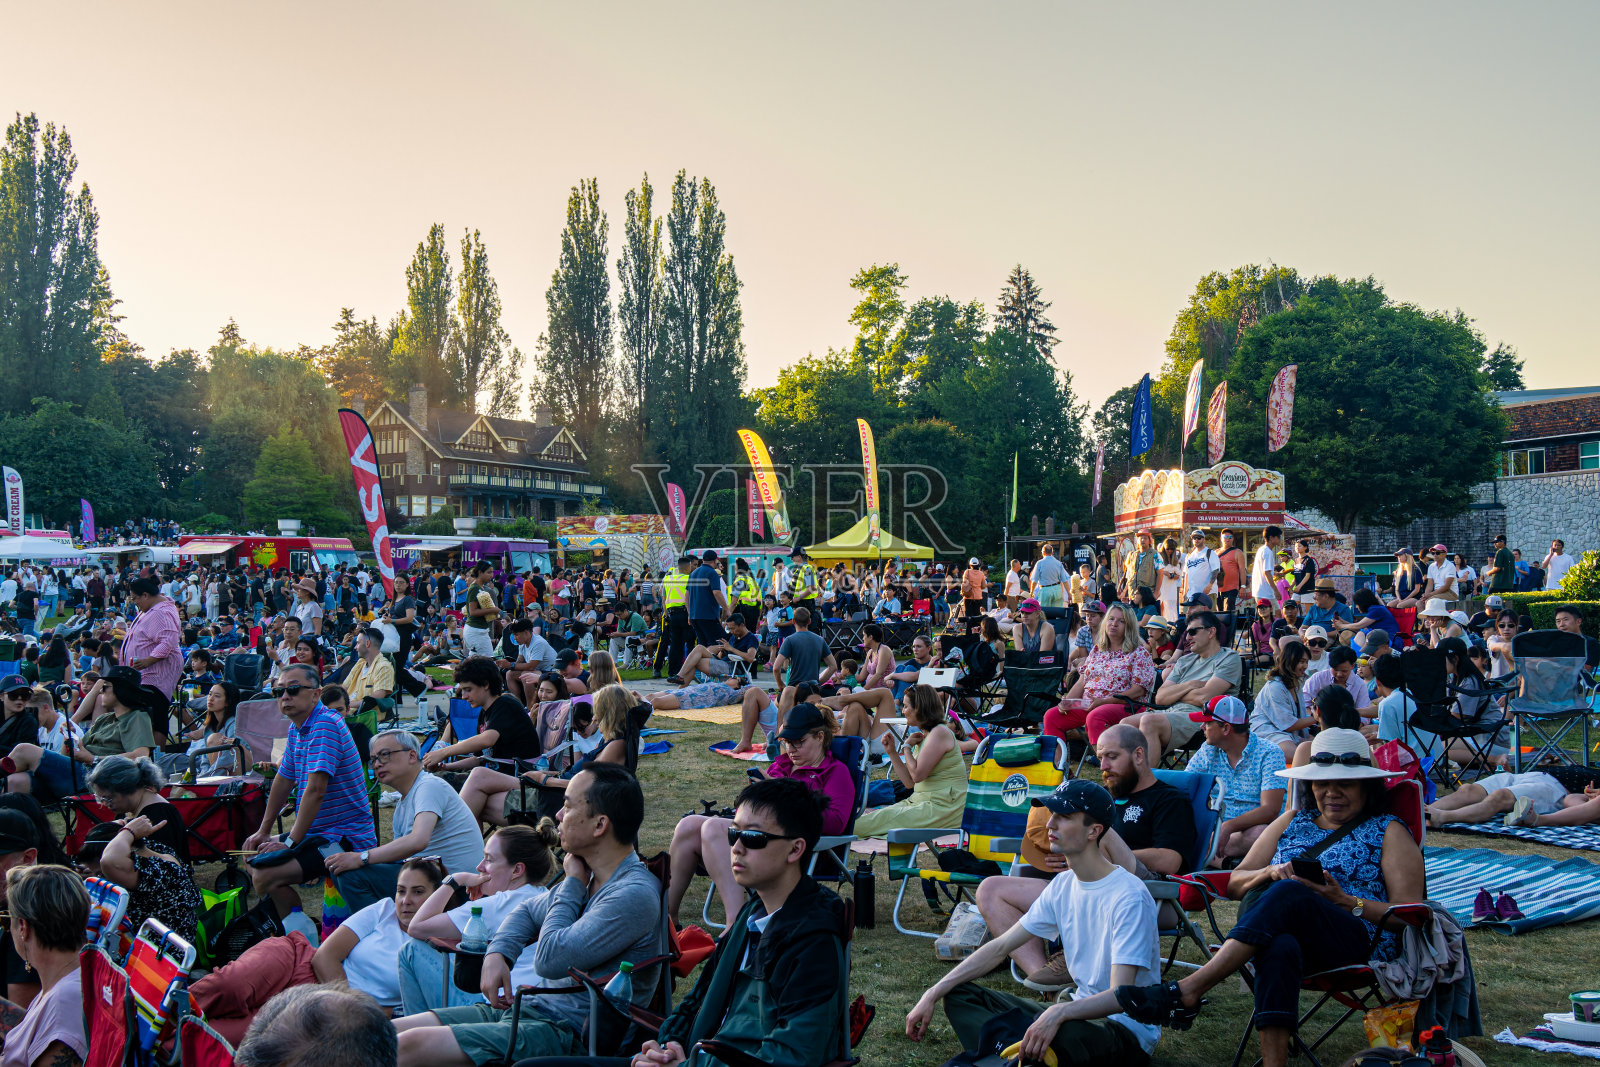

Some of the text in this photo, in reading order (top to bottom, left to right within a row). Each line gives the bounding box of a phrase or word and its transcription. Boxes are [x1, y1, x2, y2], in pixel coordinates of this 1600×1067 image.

[1275, 371, 1286, 446] KETTLE CORN
[1221, 472, 1247, 482] Cravings
[10, 487, 20, 516] CREAM
[673, 486, 682, 533] ICE CREAM
[11, 517, 21, 531] ICE
[752, 502, 760, 530] CREAM
[390, 548, 421, 559] SUPER
[1074, 549, 1090, 558] COFFEE
